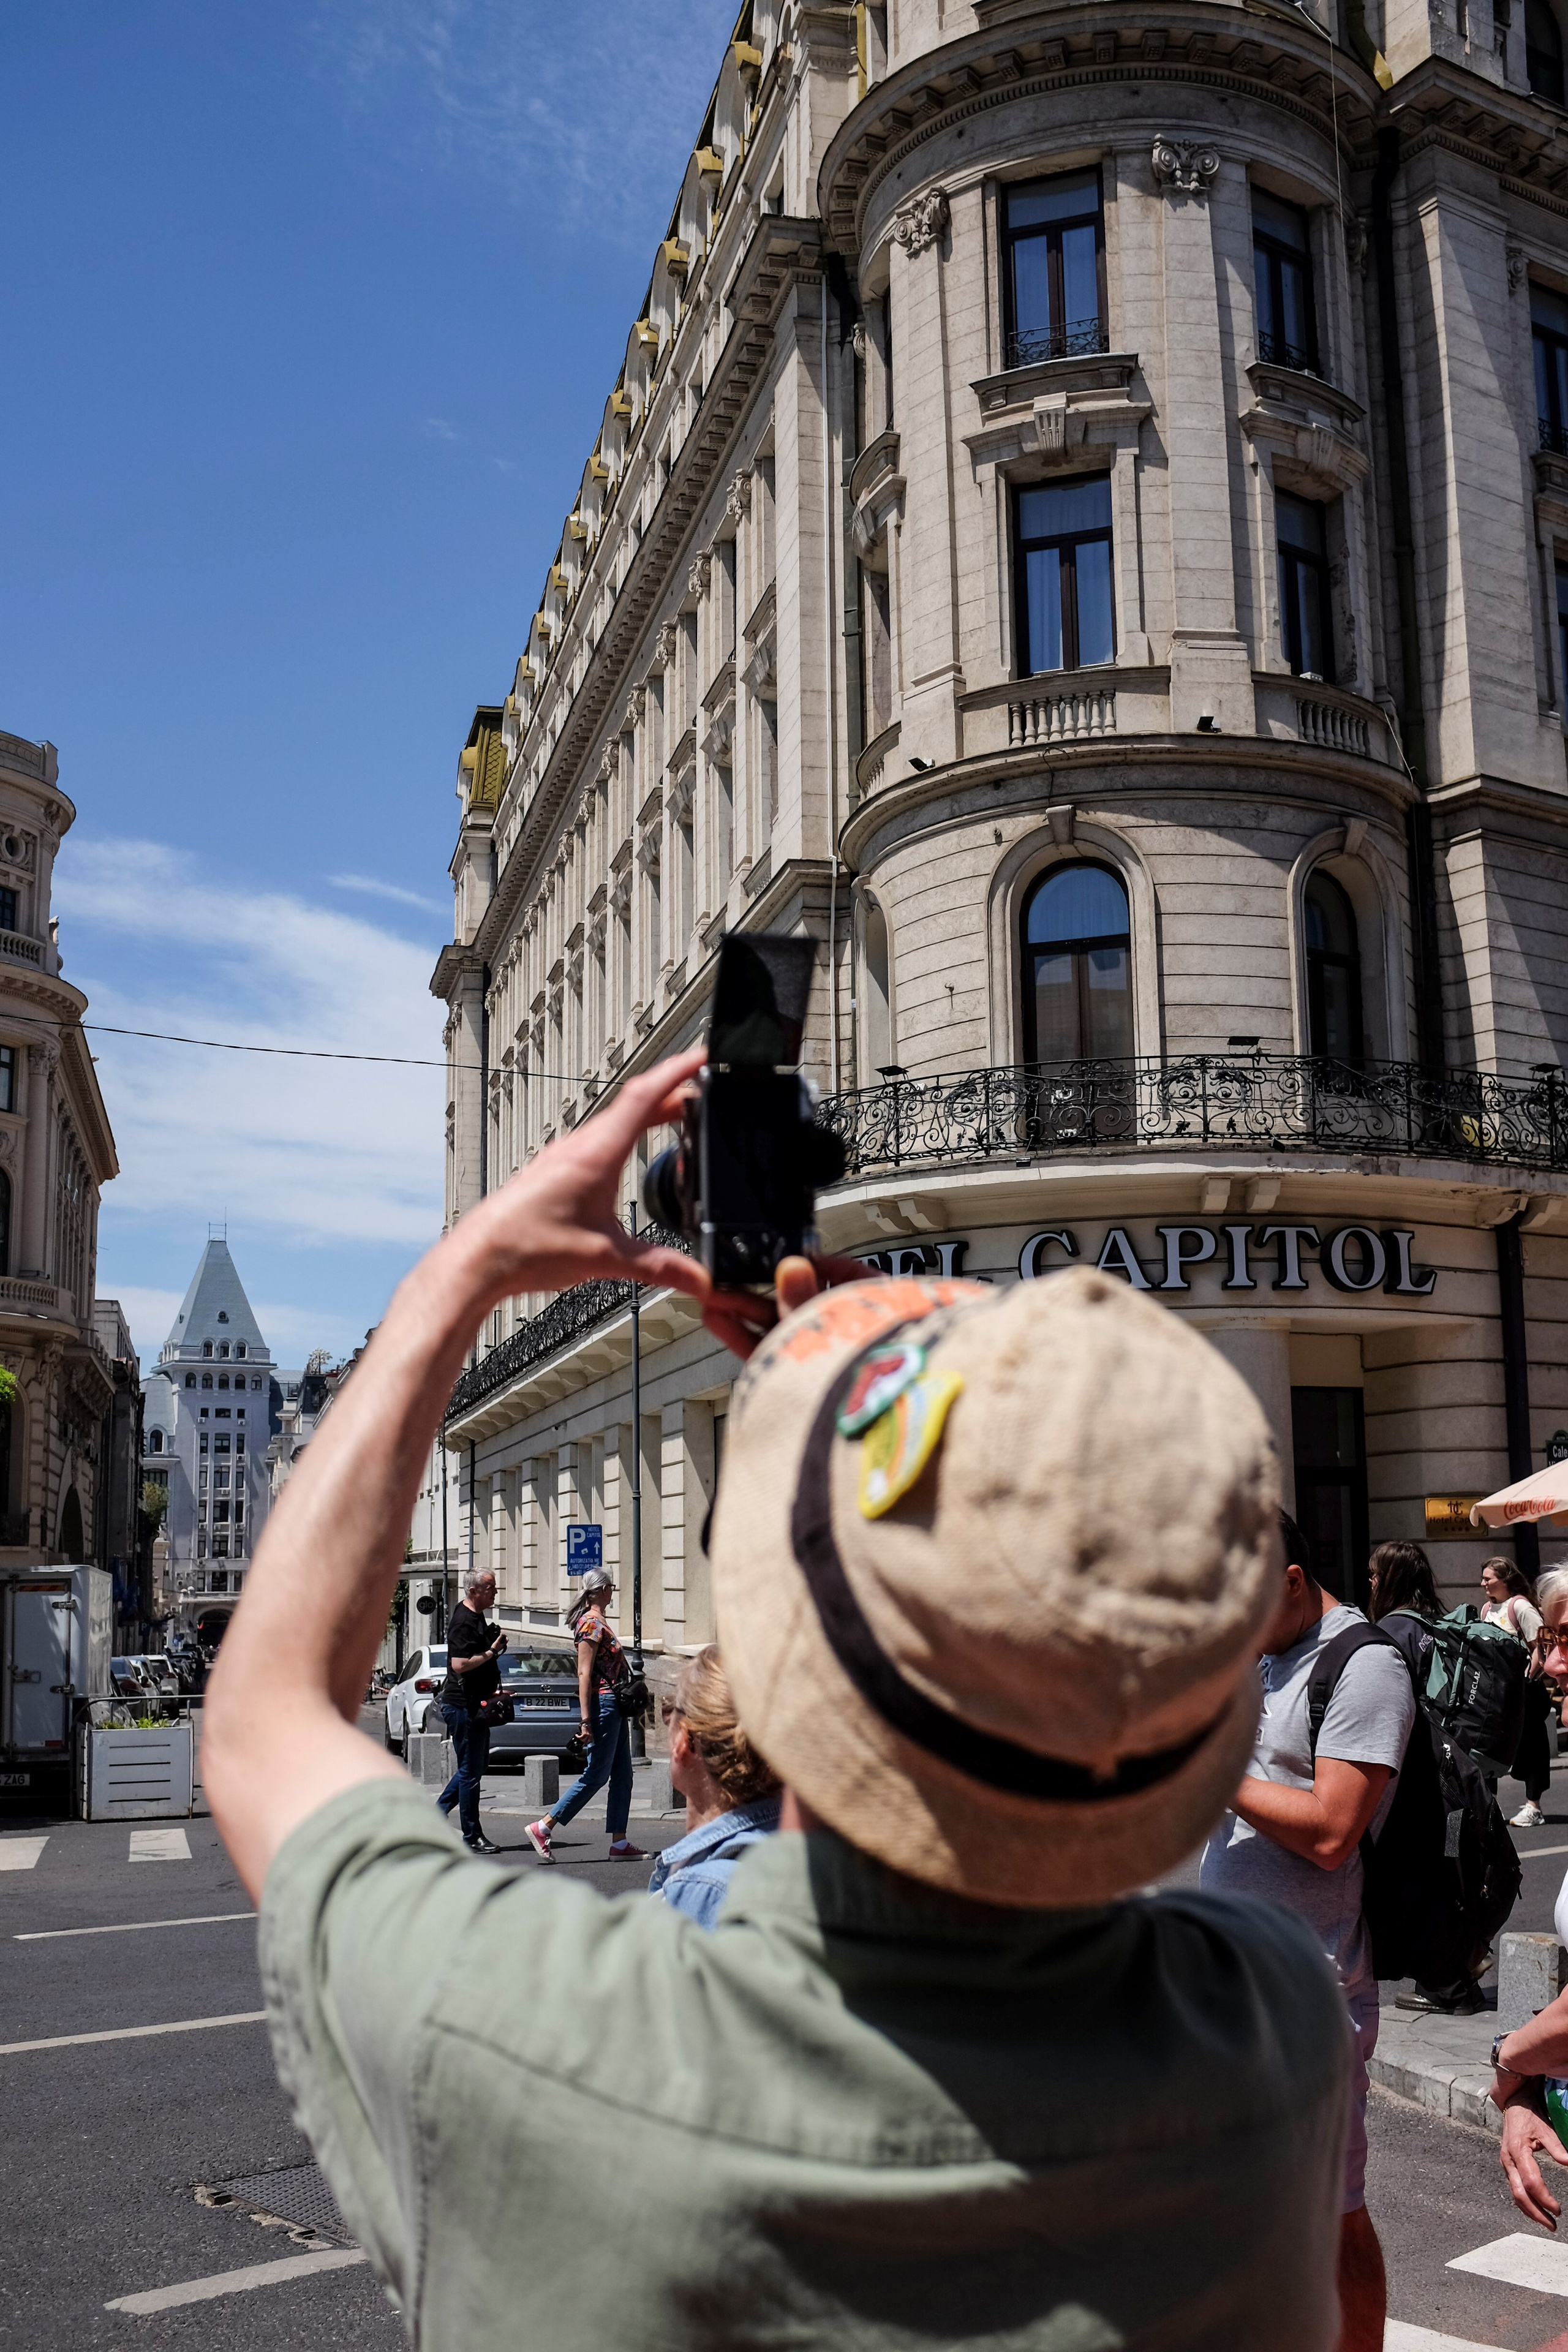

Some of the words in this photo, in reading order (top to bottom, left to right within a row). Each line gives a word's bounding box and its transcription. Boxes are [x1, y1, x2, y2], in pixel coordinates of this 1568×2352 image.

[1019, 1225, 1437, 1294] CAPITOL
[569, 1528, 586, 1554] P
[419, 1600, 434, 1611] glo
[1468, 1670, 1481, 1705] FORCLAZ
[4, 1775, 25, 1785] ZAG
